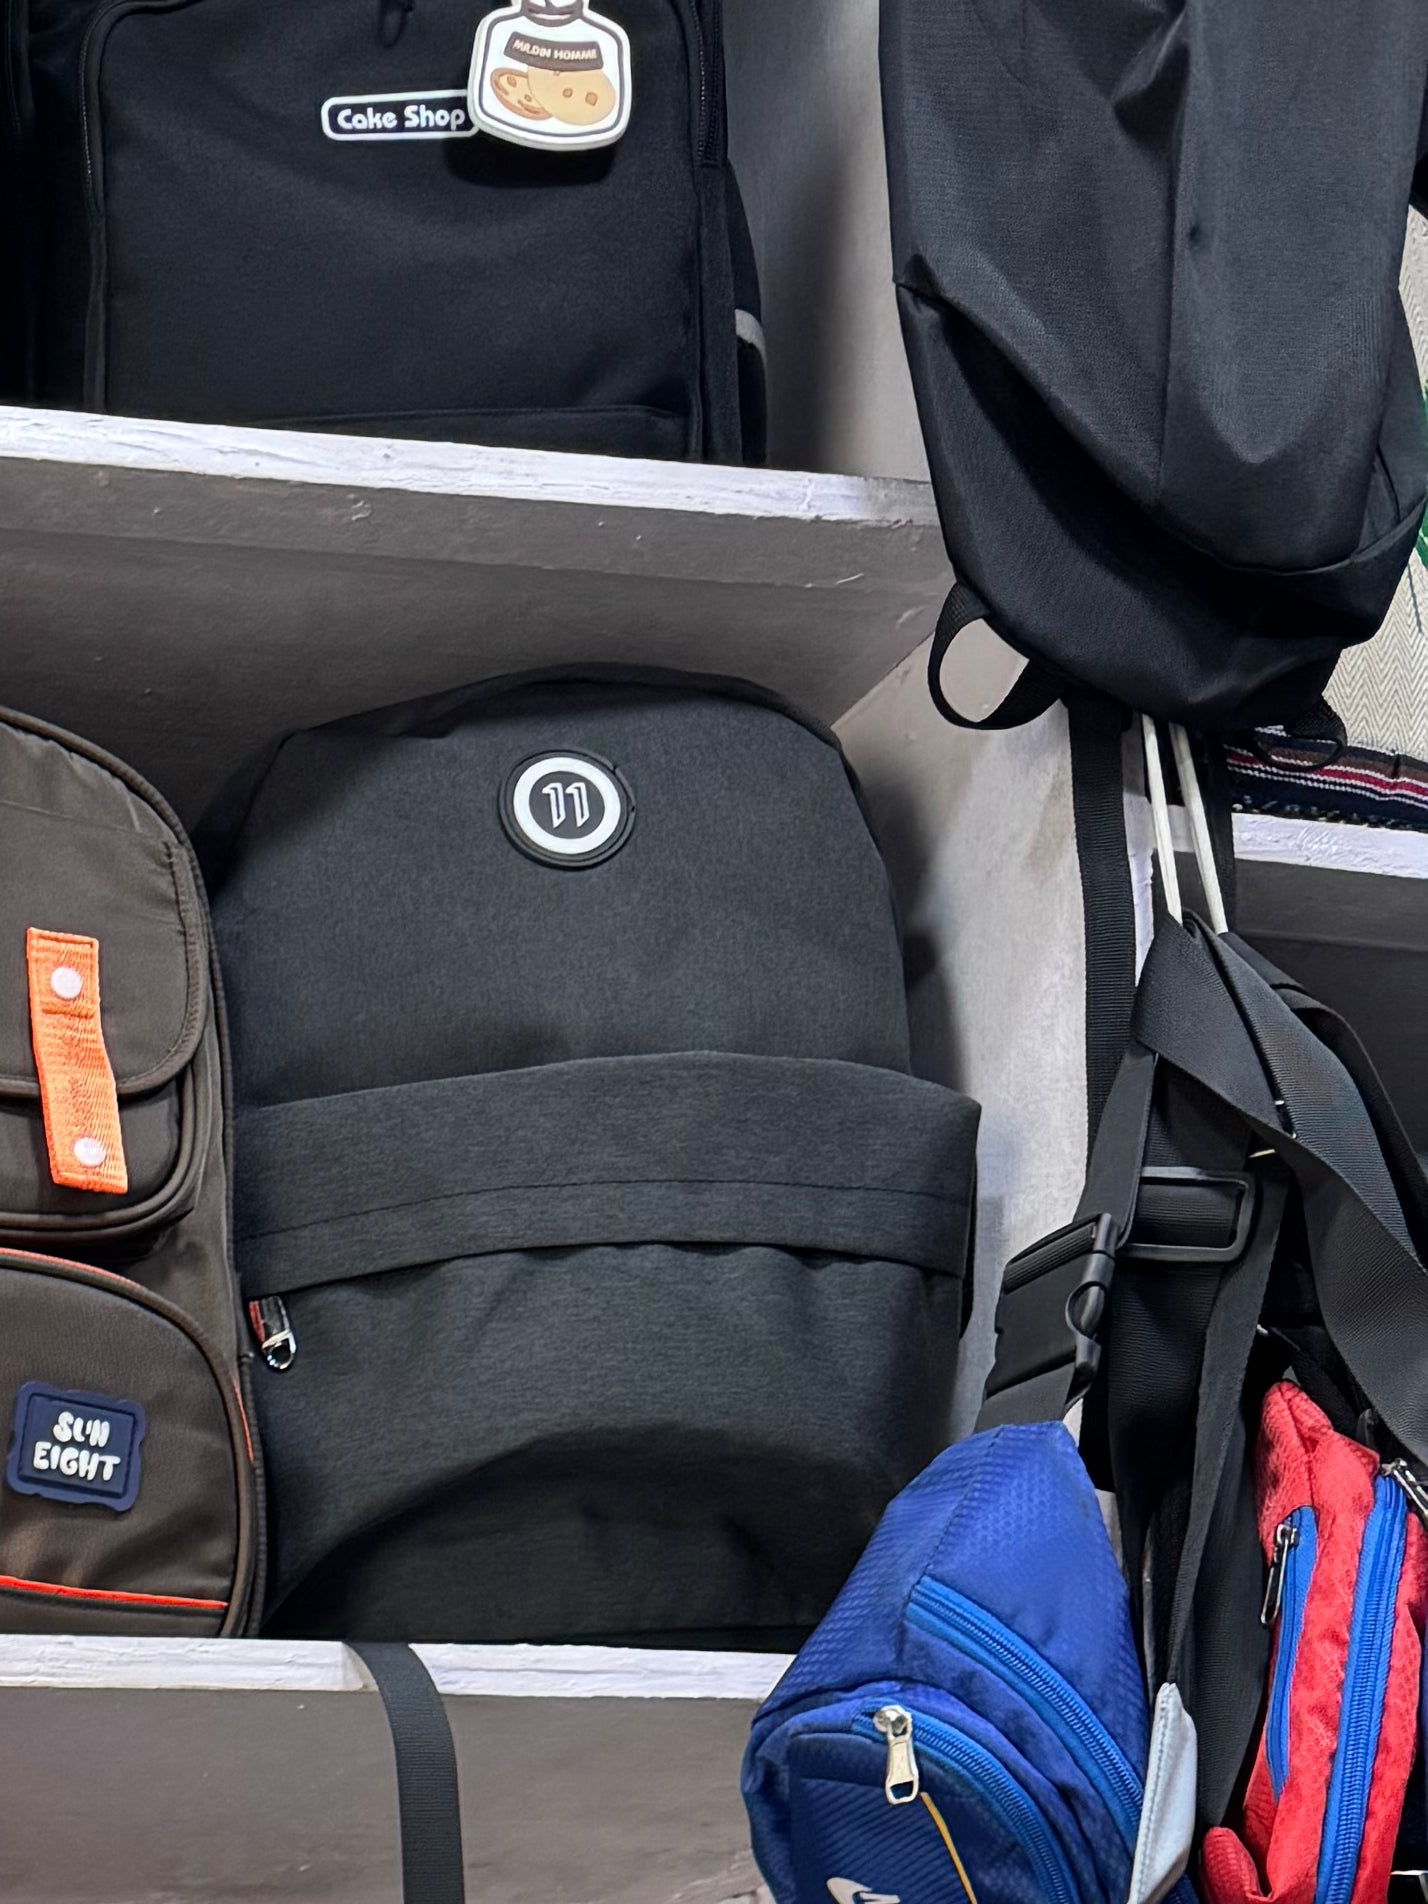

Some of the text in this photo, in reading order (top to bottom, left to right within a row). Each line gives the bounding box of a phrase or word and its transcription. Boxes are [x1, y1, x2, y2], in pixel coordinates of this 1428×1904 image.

[336, 104, 466, 131] Cake Shop
[541, 781, 590, 829] 11
[33, 1441, 122, 1482] EIGHT
